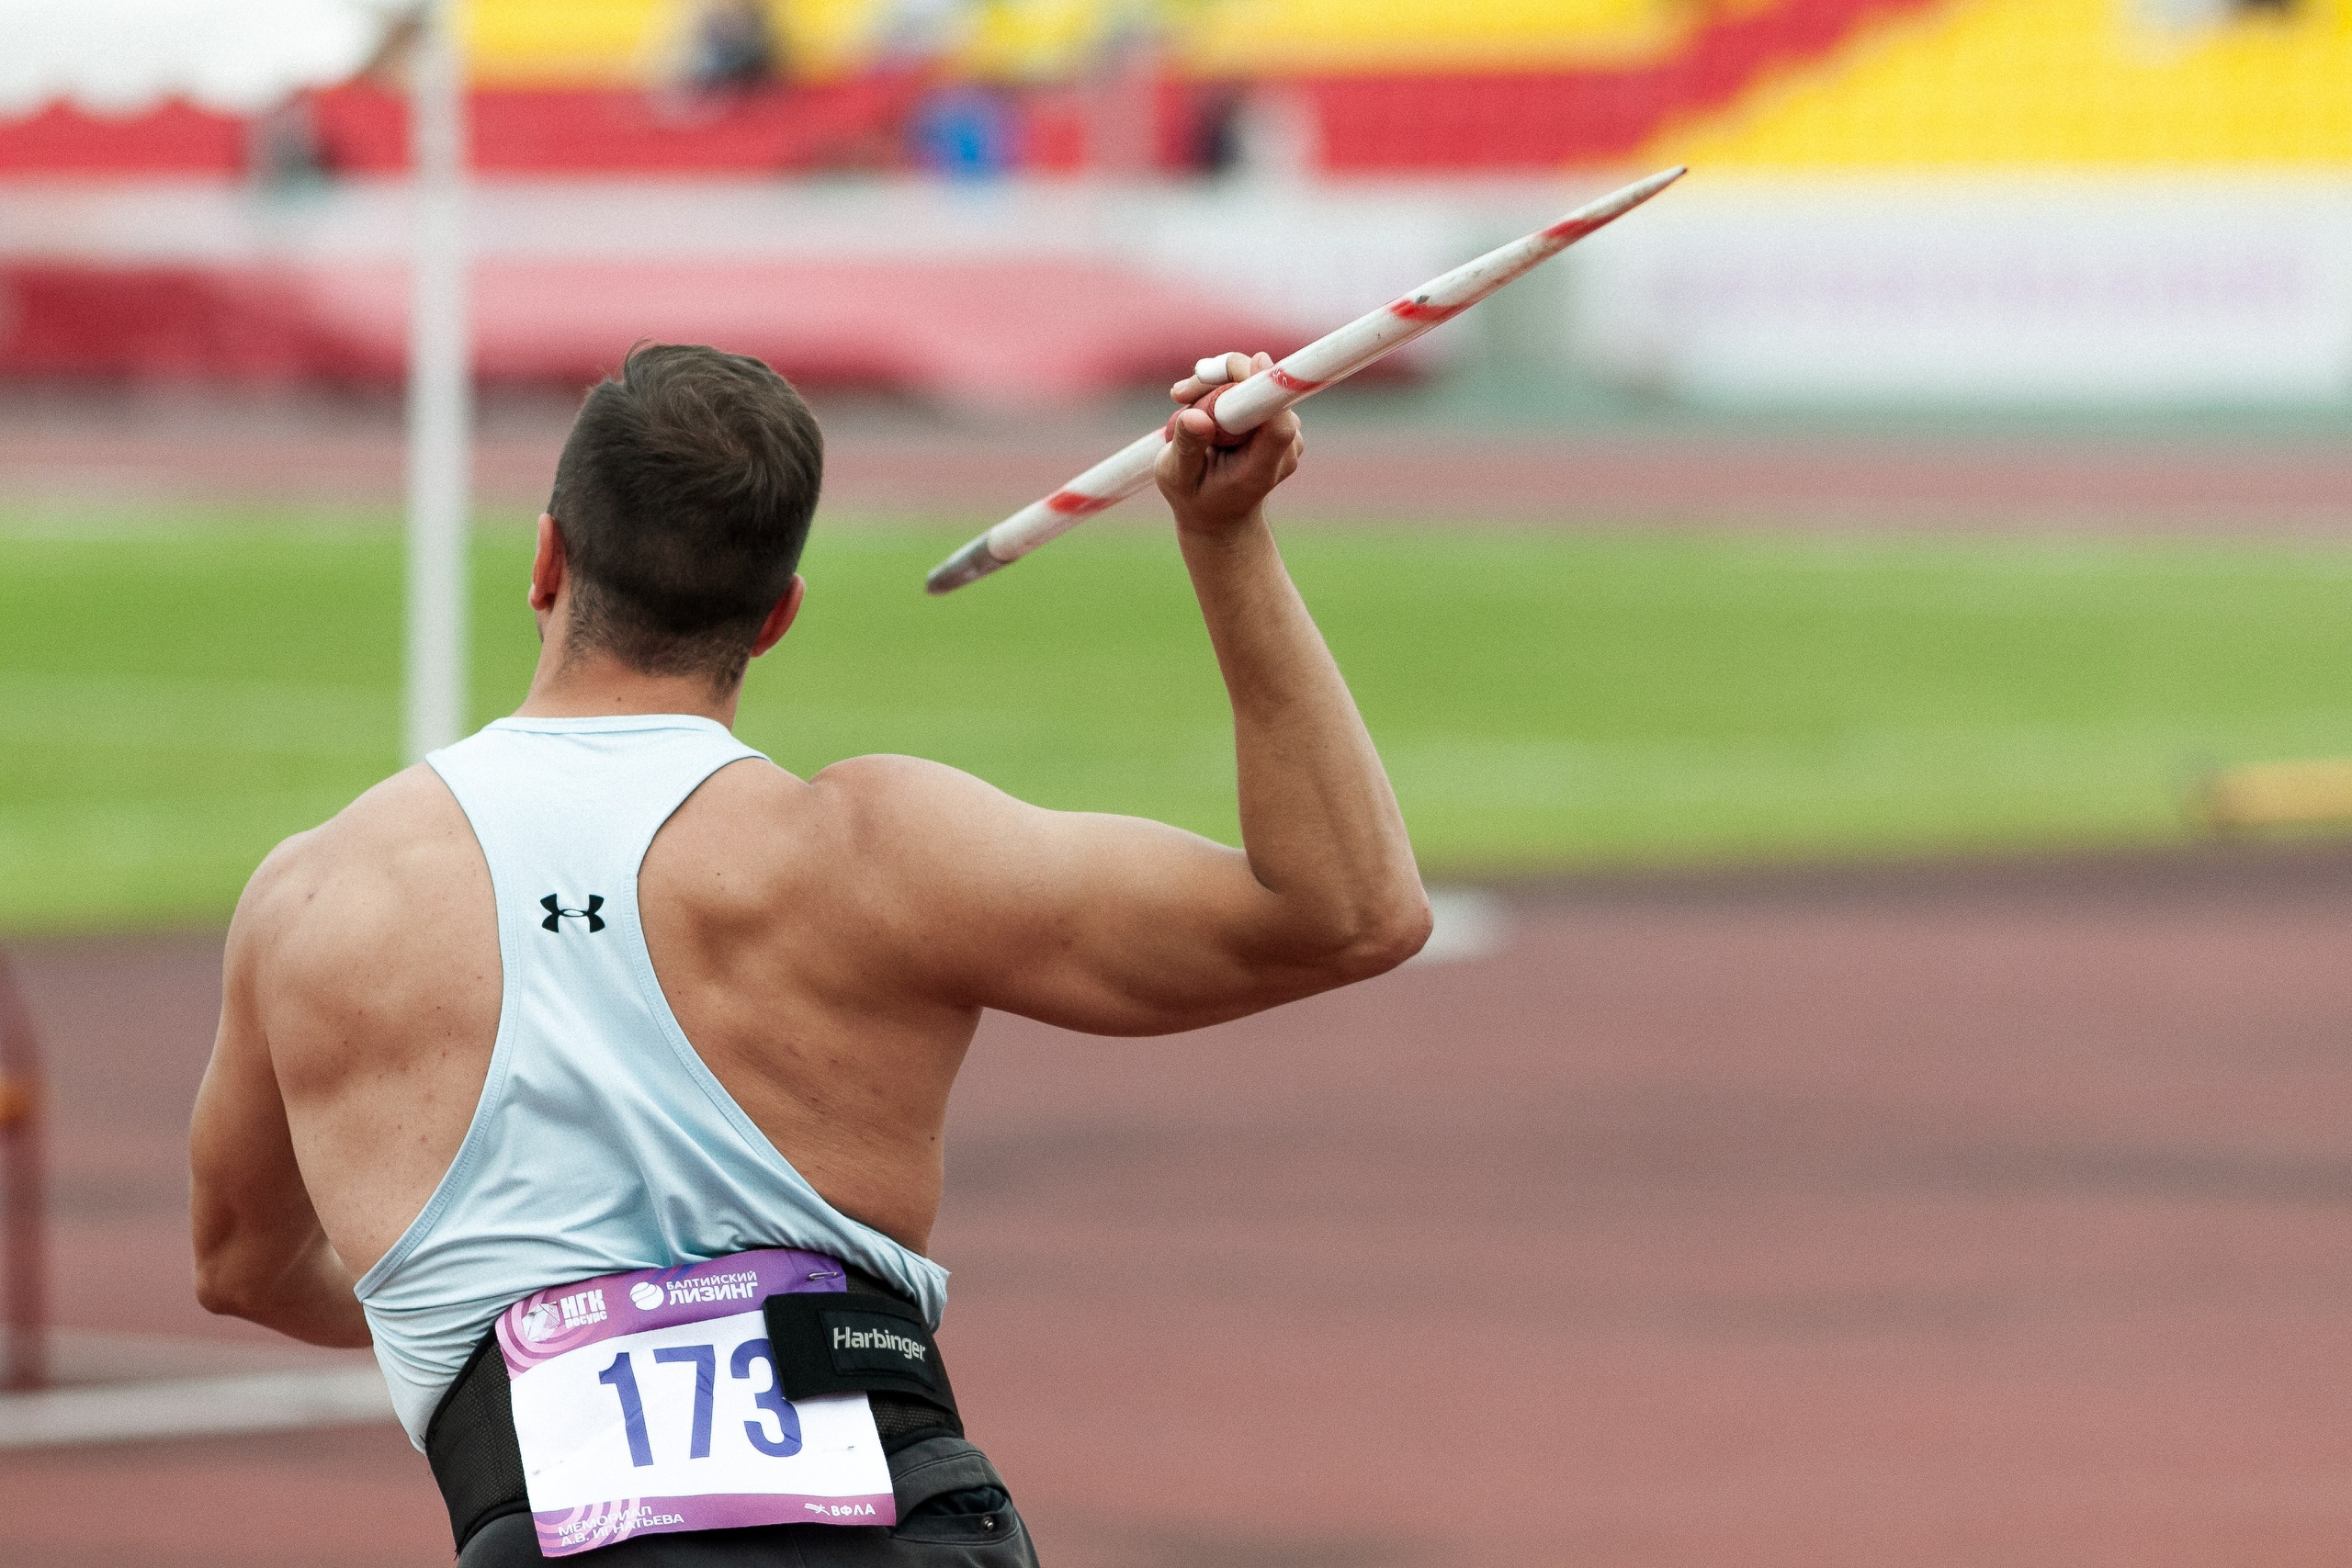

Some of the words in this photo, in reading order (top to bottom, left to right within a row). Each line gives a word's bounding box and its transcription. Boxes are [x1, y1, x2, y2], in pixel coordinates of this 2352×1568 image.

[666, 1270, 757, 1290] БАЛТИЙСКИЙ
[669, 1281, 758, 1305] ЛИЗИНГ
[560, 1289, 605, 1319] НГК
[833, 1326, 925, 1361] Harbinger
[598, 1338, 803, 1467] 173
[558, 1506, 652, 1536] МЕМОРИАЛ
[831, 1503, 876, 1517] ВФЛА
[561, 1532, 590, 1547] А.В.
[594, 1513, 684, 1538] ИГНАТЬЕВА
